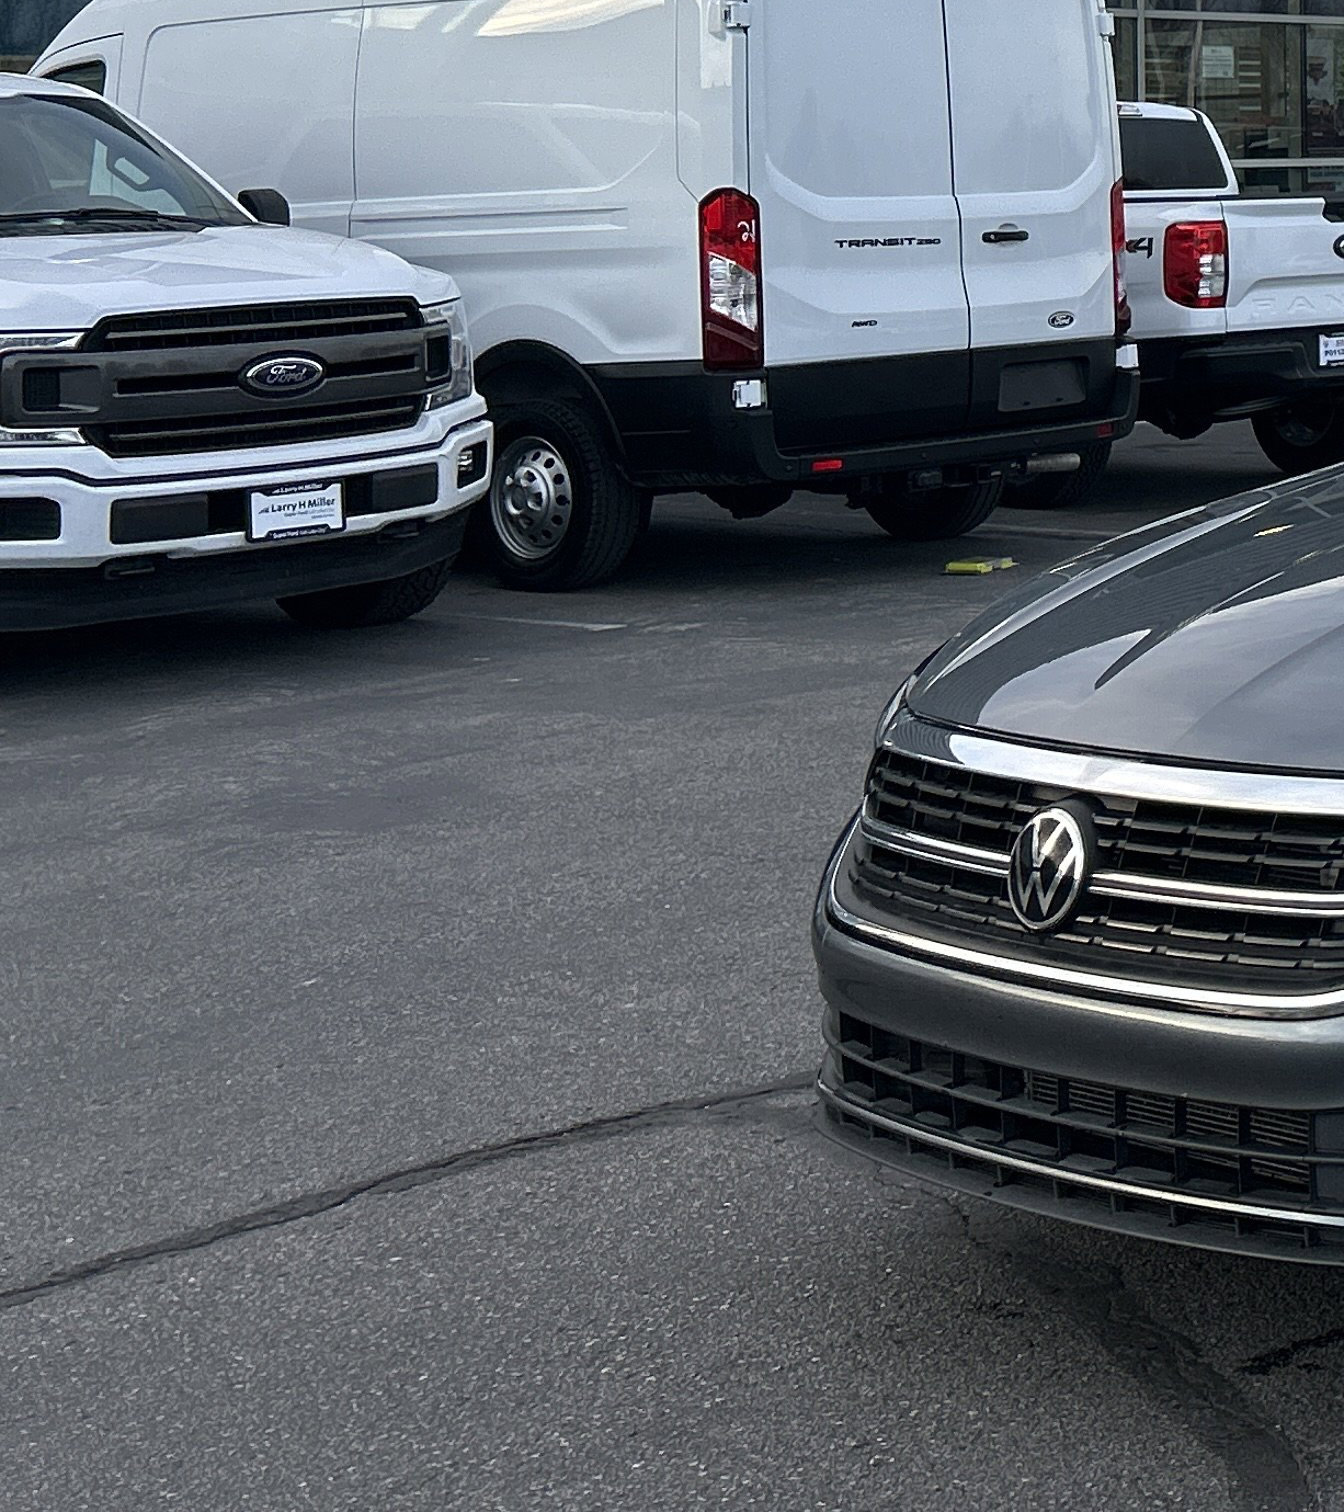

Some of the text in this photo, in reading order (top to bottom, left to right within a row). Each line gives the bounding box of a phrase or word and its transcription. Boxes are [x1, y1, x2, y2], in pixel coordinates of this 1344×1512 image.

[834, 238, 916, 248] TRANSIT
[271, 497, 335, 512] Larry H Miller
